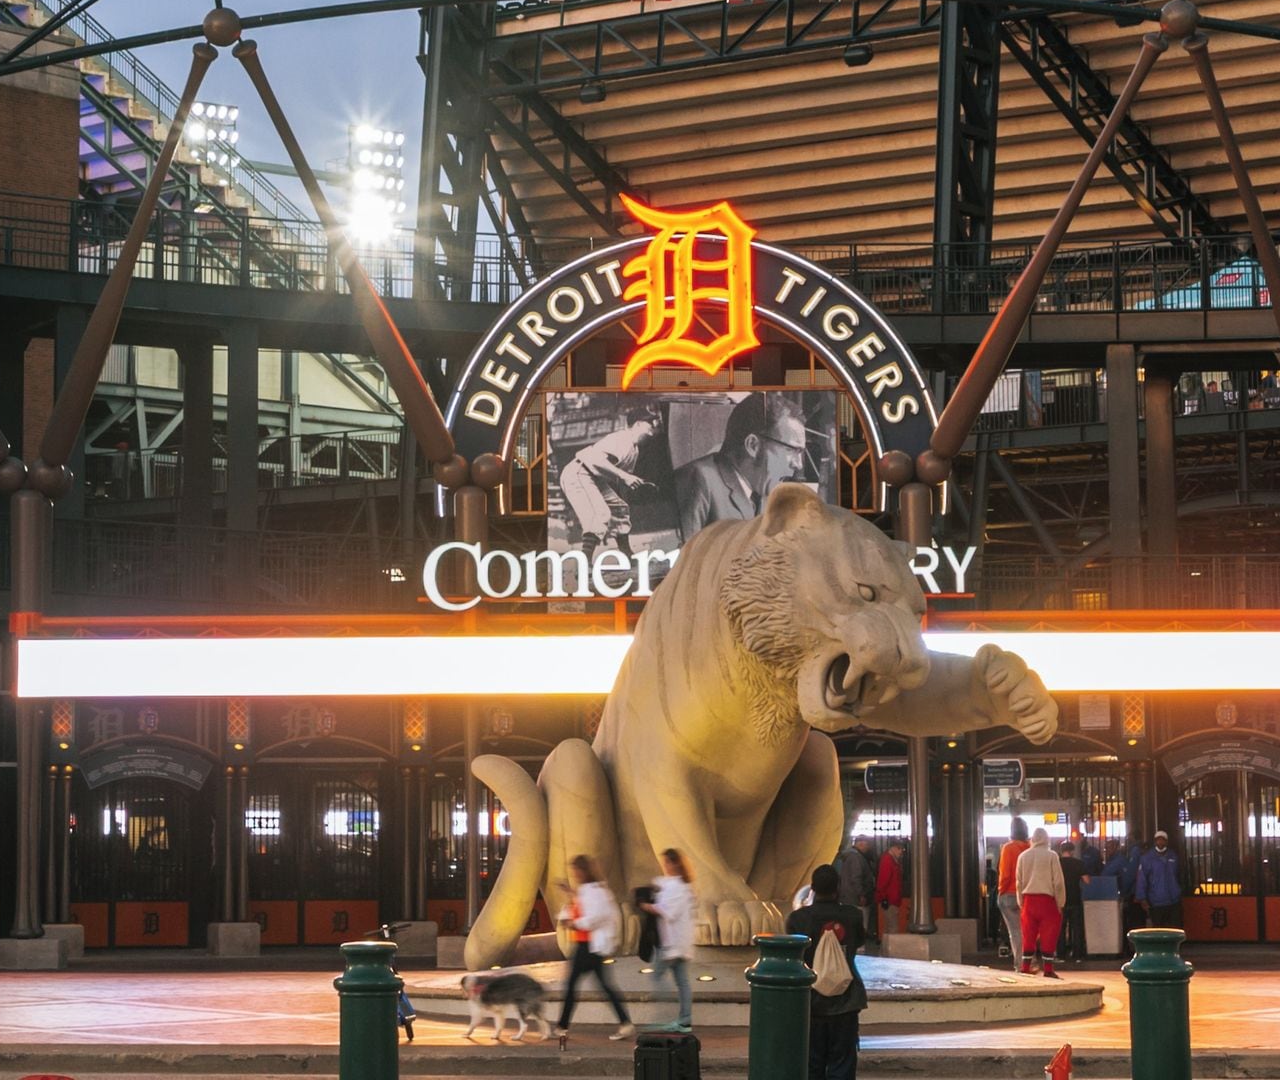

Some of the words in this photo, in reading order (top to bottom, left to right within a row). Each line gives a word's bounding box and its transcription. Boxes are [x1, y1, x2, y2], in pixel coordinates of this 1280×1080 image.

[465, 259, 623, 426] DETROIT
[773, 266, 920, 424] TIGERS
[422, 541, 681, 612] Comer
